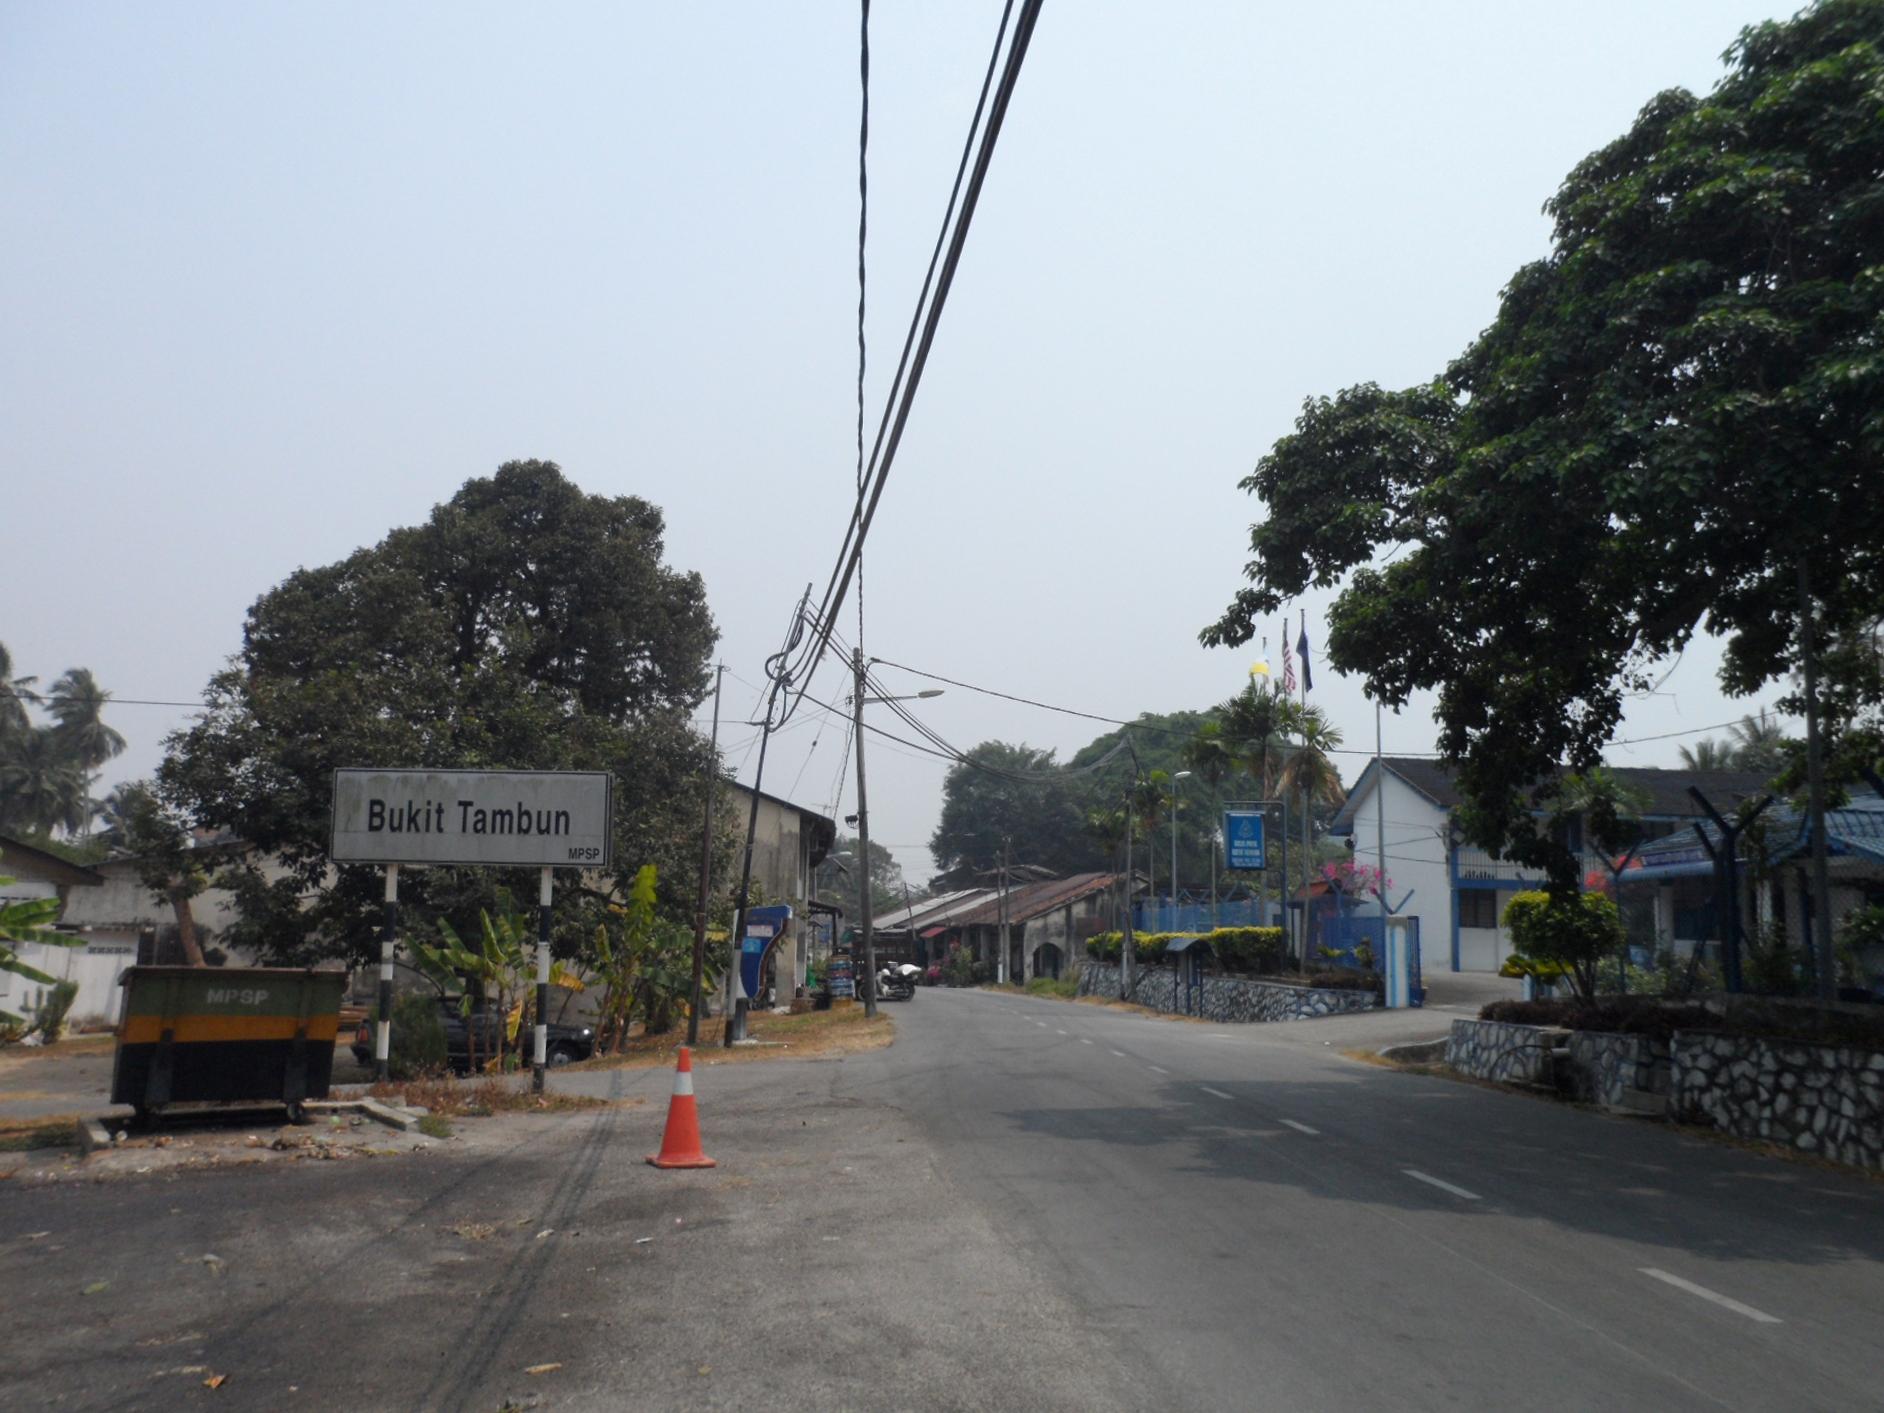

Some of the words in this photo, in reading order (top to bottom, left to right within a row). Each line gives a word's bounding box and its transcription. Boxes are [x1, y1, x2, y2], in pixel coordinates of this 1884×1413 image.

[368, 799, 445, 833] Bukit
[457, 800, 570, 836] Tambun
[568, 847, 600, 861] MPSP
[207, 988, 269, 1005] MPSP
